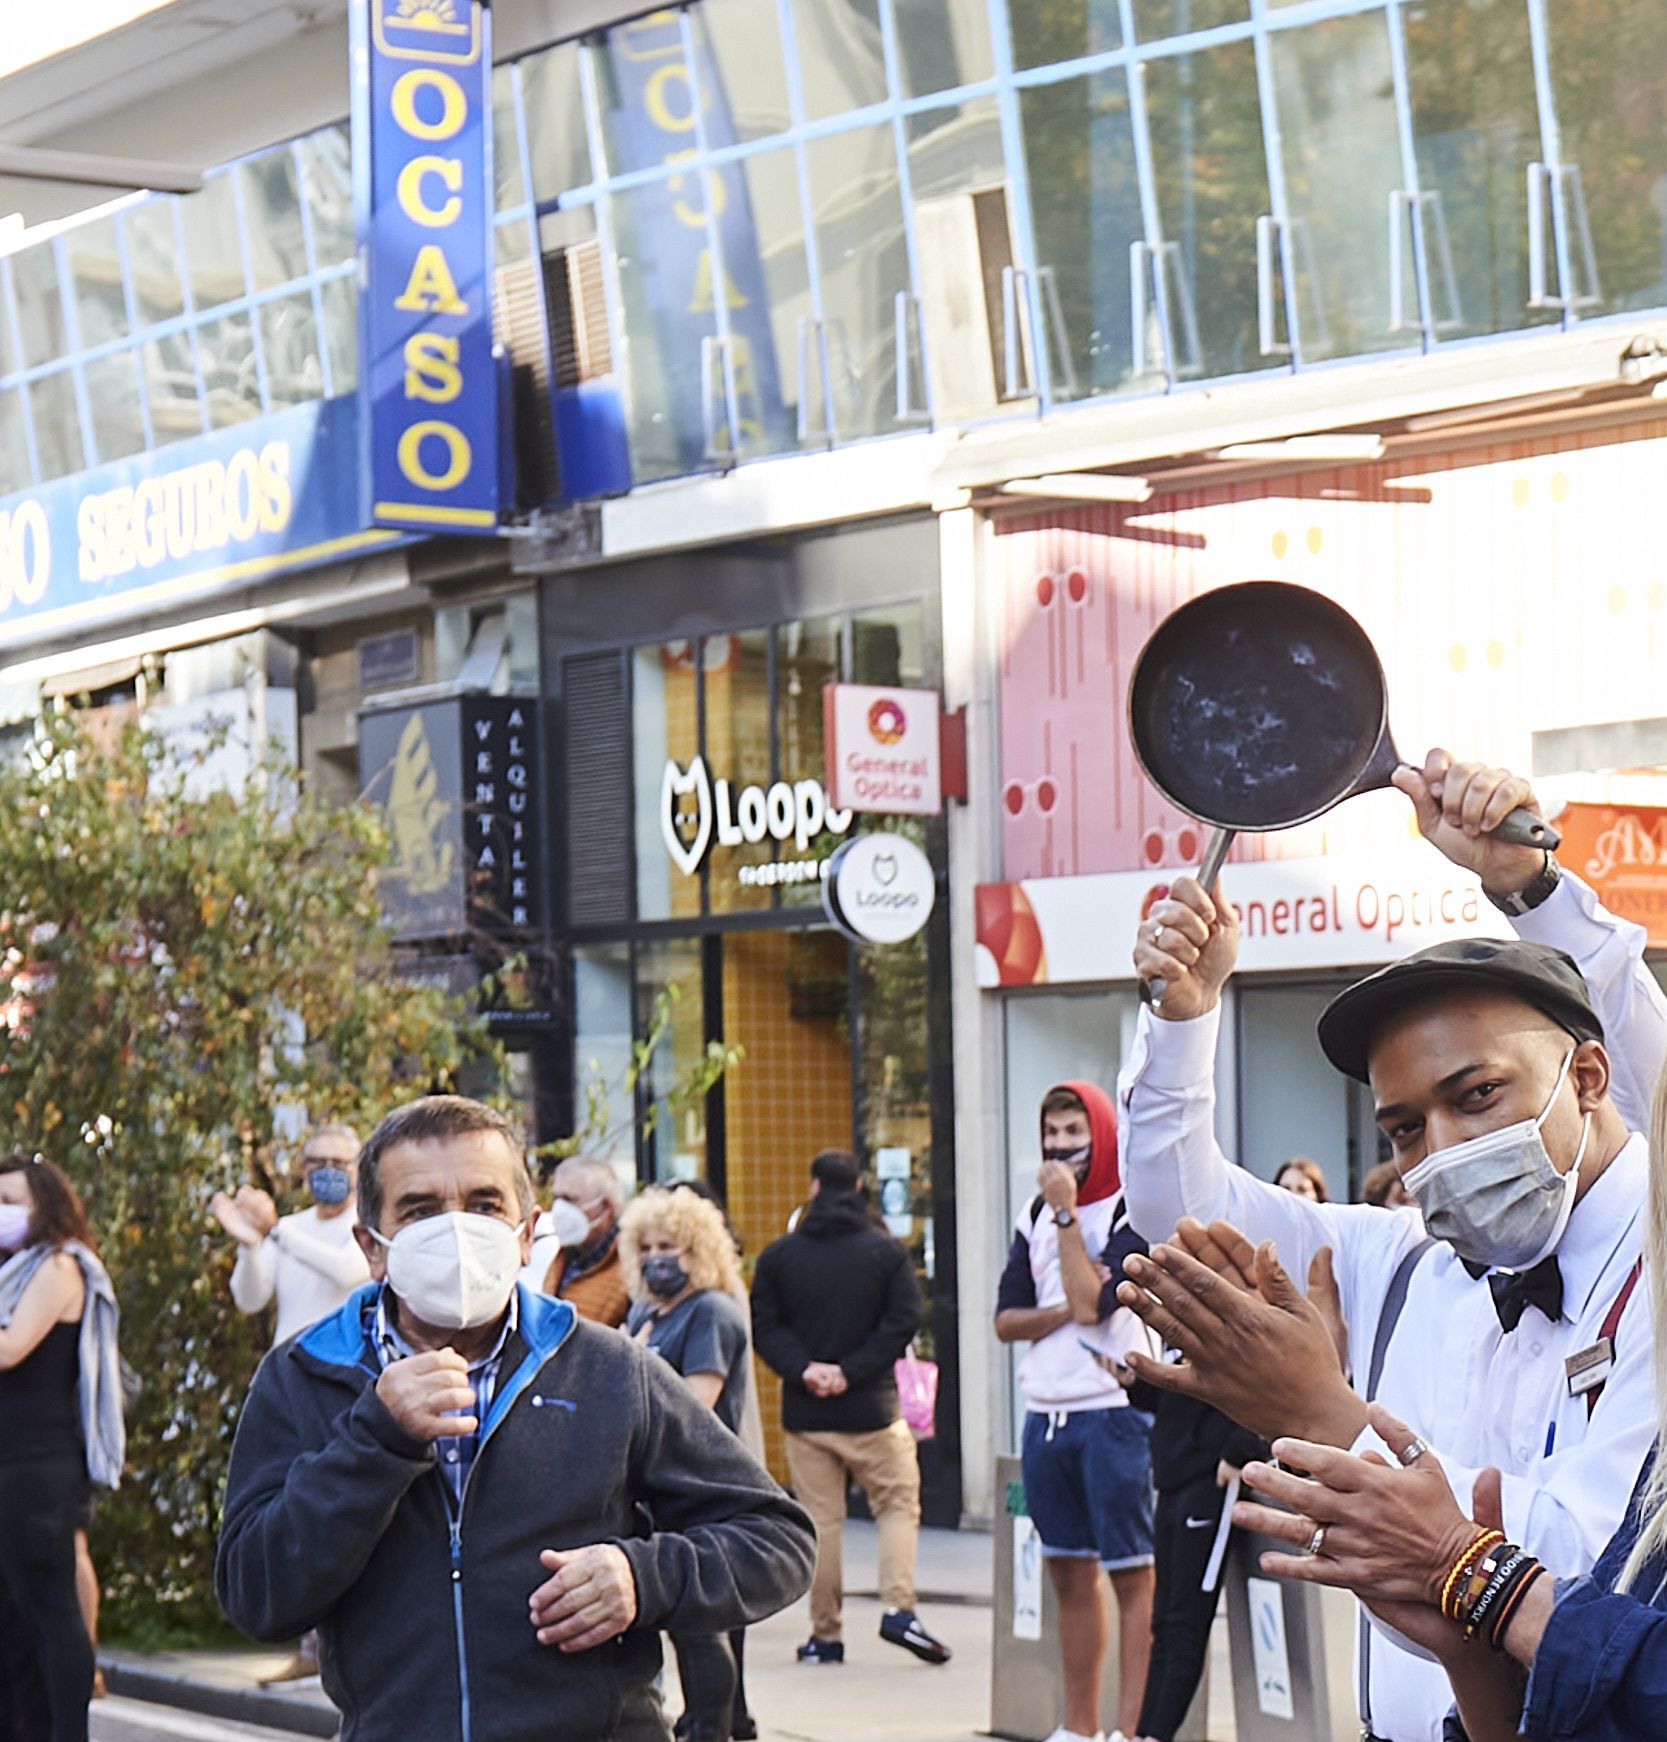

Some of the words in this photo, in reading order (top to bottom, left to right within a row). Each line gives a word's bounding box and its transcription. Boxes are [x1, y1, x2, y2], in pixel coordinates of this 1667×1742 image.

[389, 68, 472, 491] OCASO
[0, 500, 50, 613] O
[77, 441, 292, 583] SEGUROS
[474, 720, 496, 867] VENTA
[506, 708, 529, 926] ALQUILER
[846, 752, 929, 777] General
[1231, 884, 1343, 935] eneral
[1356, 883, 1480, 942] Optica
